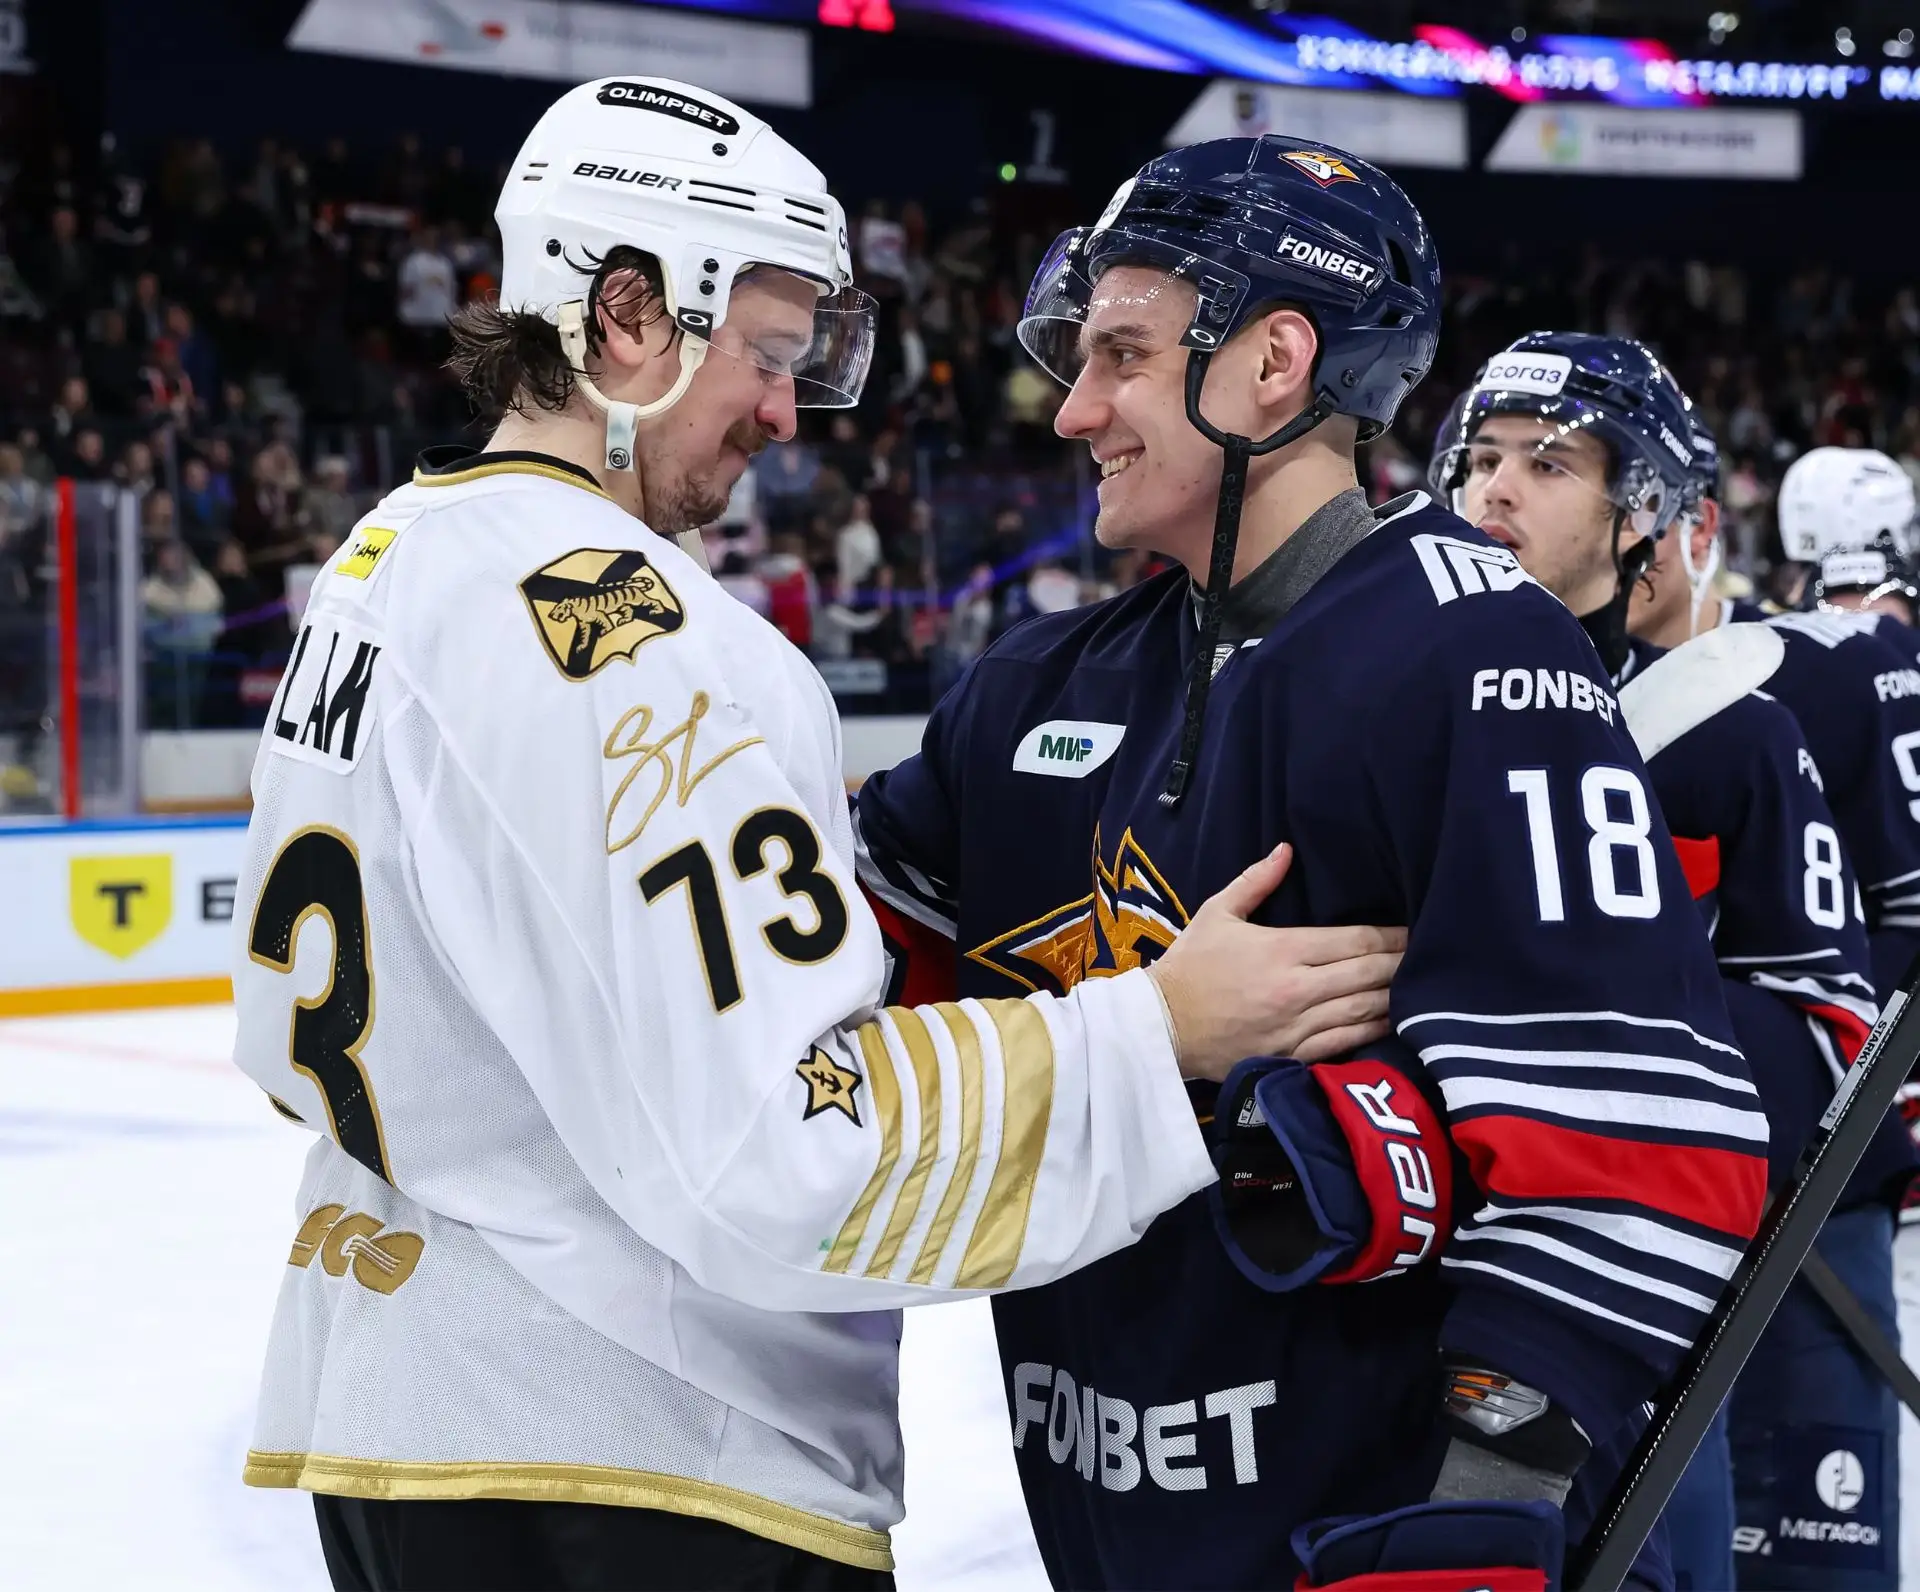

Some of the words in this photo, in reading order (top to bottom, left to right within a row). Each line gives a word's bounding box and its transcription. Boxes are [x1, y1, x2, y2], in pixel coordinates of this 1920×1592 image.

[608, 86, 730, 129] OLIMPBET
[571, 161, 683, 192] BAUER
[1277, 237, 1375, 282] FONBET
[1471, 667, 1617, 728] FONBET
[1038, 733, 1094, 763] МИР
[1507, 765, 1662, 922] 18
[636, 803, 850, 1016] 73
[1856, 1019, 1888, 1070] STARKY
[1345, 1079, 1437, 1283] UER
[1012, 1361, 1278, 1493] FONBET
